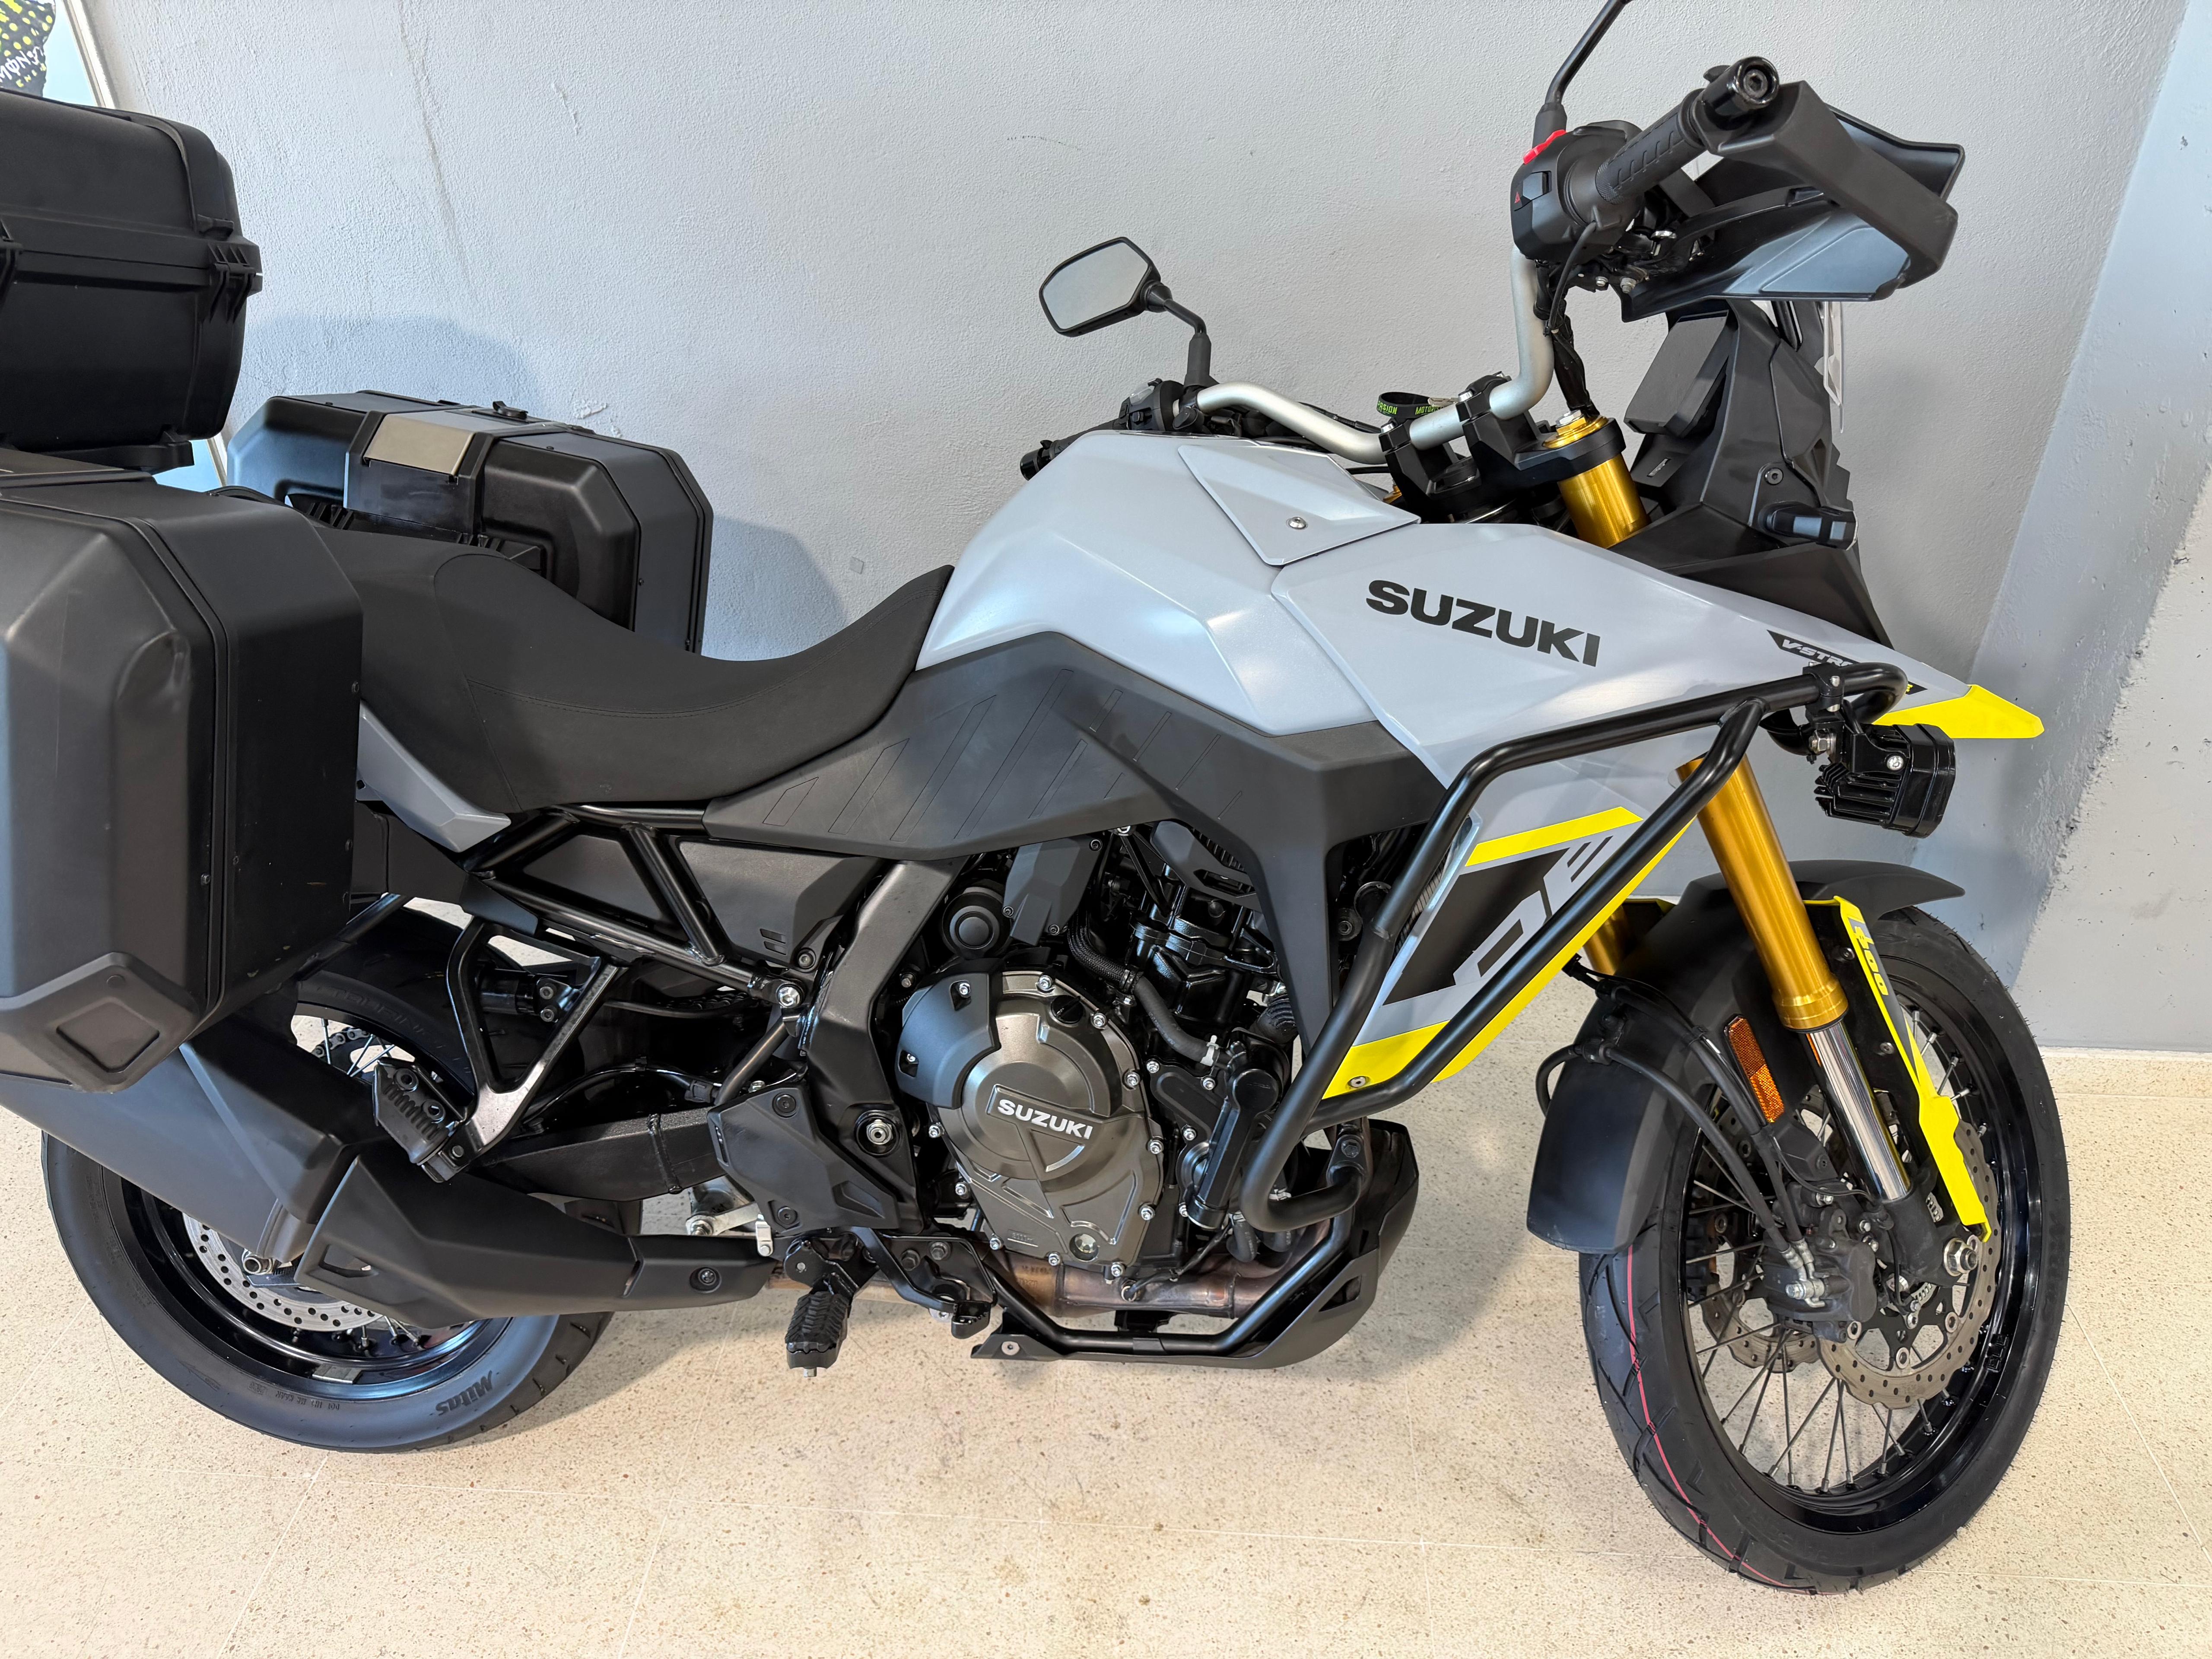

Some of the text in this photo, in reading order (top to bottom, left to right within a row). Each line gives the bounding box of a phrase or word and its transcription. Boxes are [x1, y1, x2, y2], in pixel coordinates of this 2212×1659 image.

[1365, 579, 1601, 667] SUZUKI
[997, 1098, 1093, 1140] SUZUKI
[435, 1370, 493, 1417] Mitas
